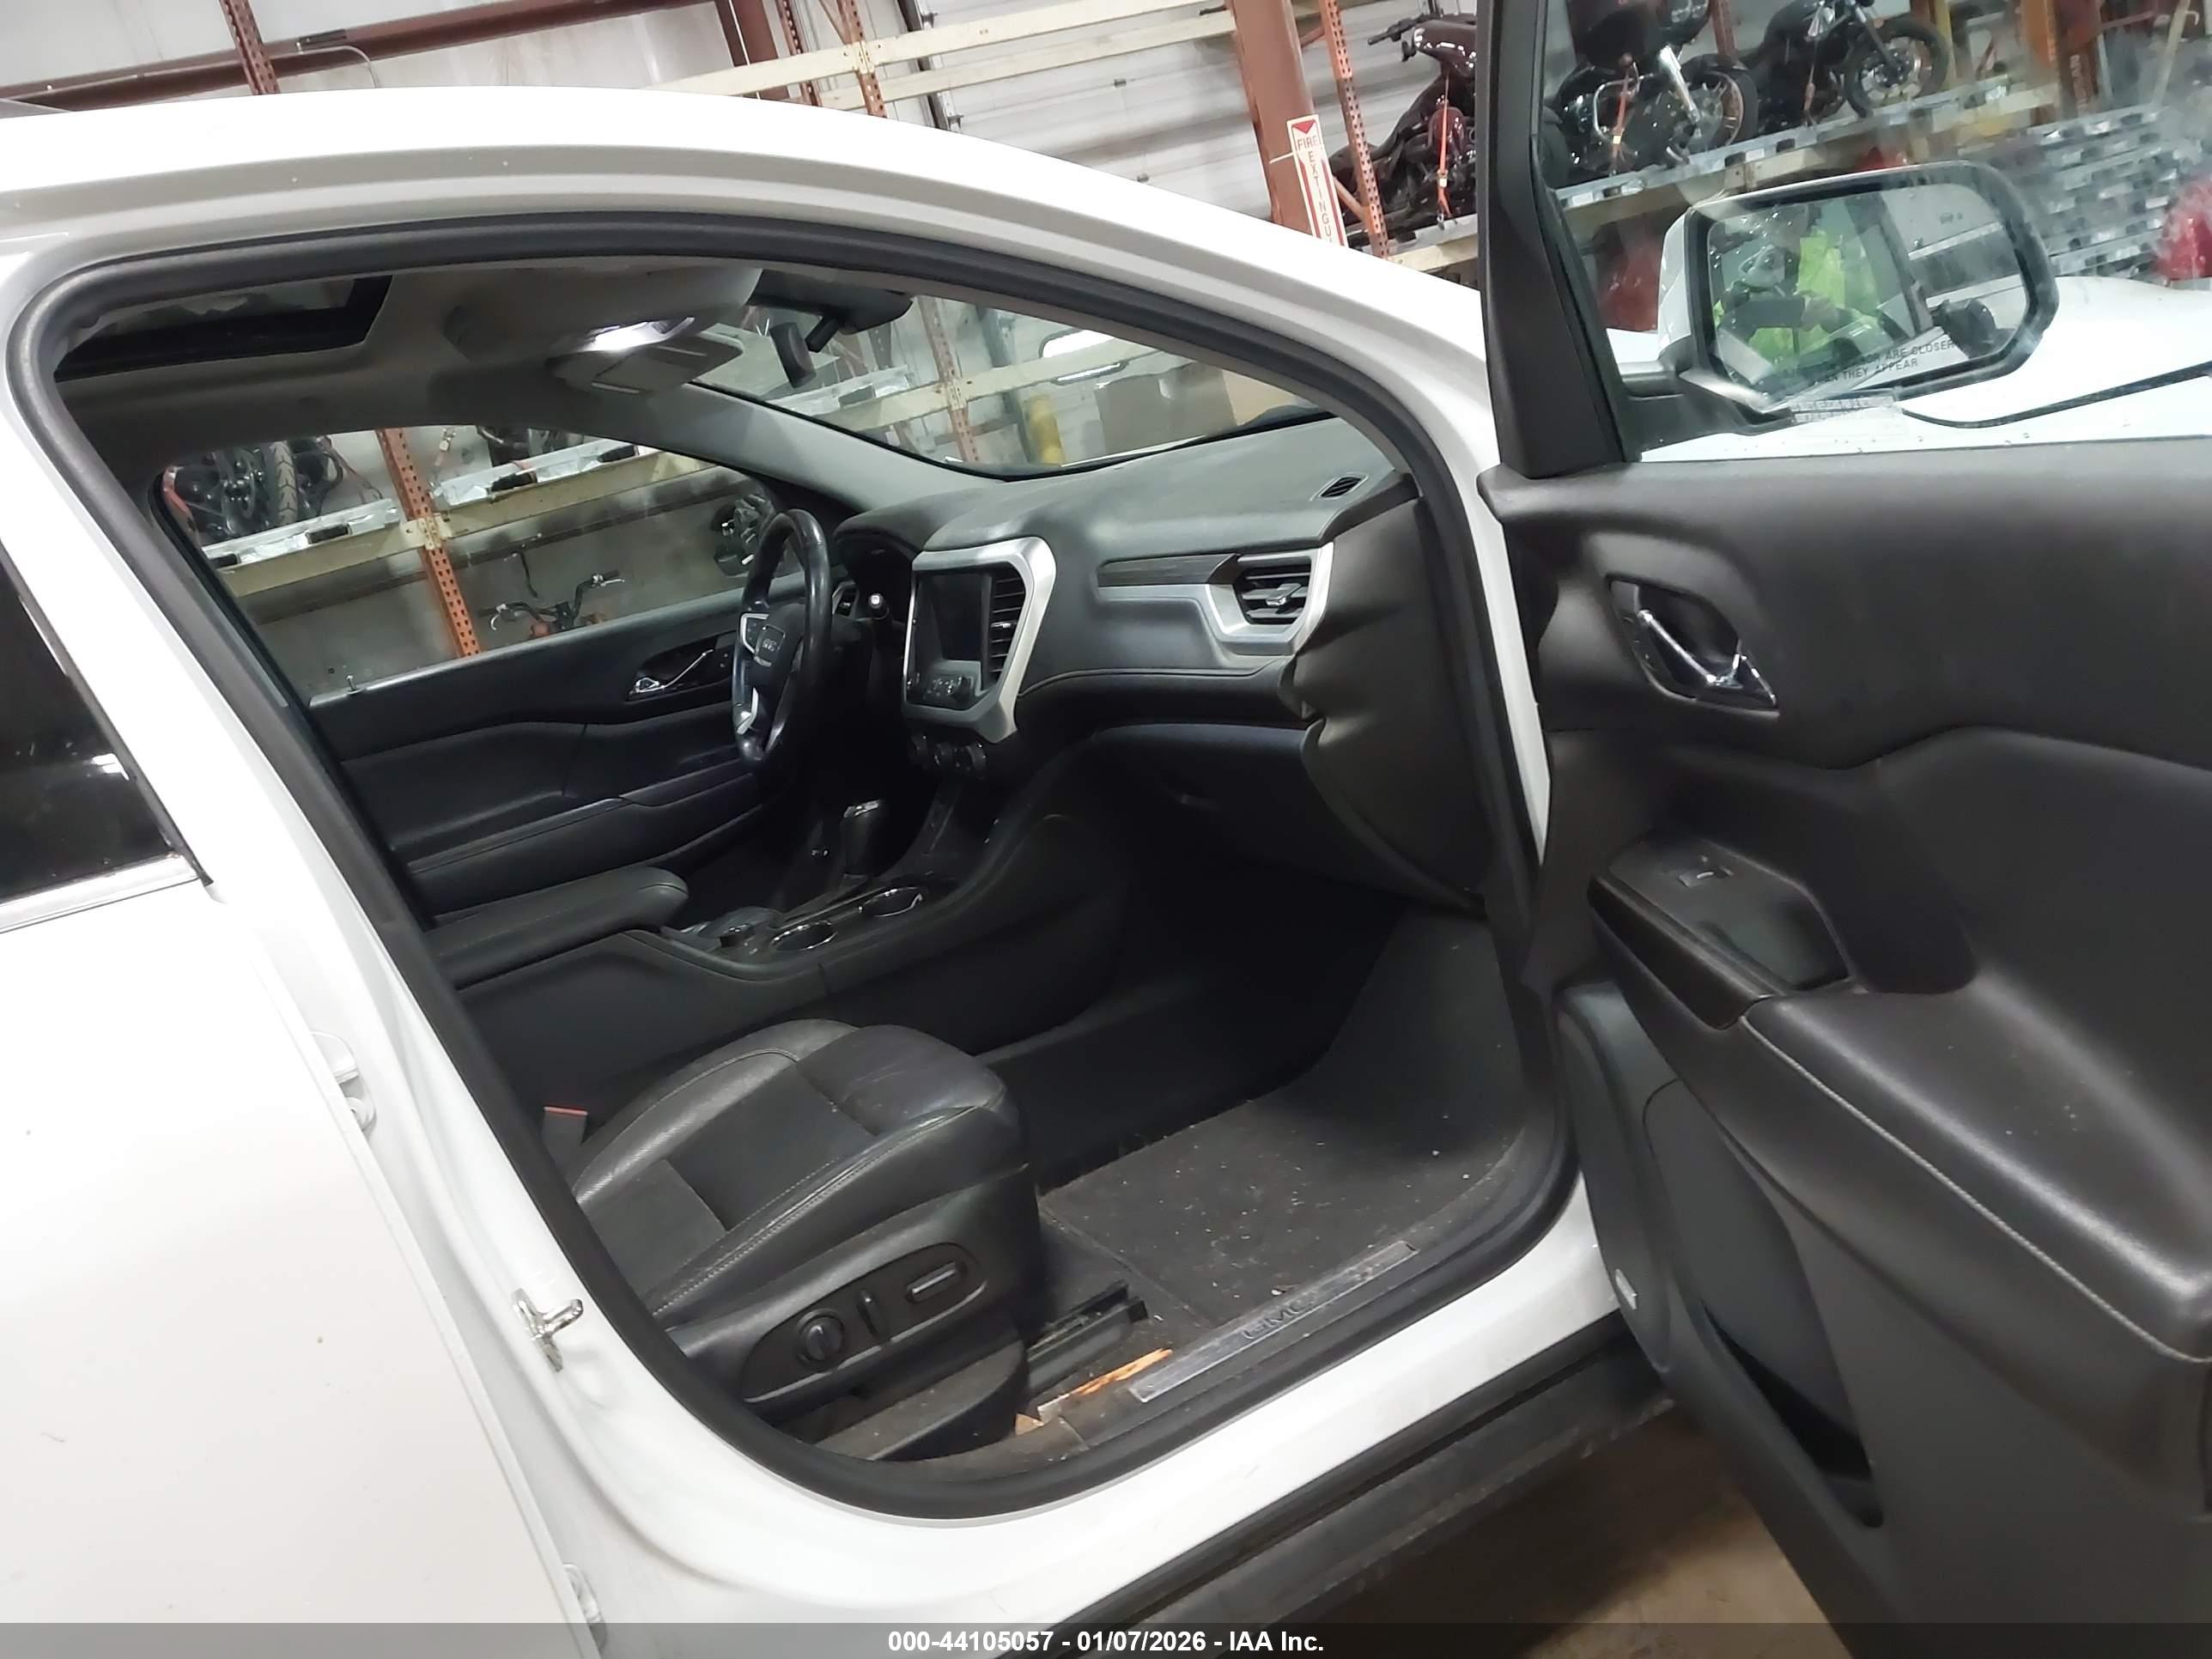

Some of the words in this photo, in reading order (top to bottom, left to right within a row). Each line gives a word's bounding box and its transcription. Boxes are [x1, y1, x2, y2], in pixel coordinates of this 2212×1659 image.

[1297, 136, 1317, 151] FIRE
[1886, 348, 1908, 360] ARE
[1911, 340, 1954, 356] CLOSER
[1843, 367, 1869, 380] THEY
[1875, 358, 1917, 374] APPEAR
